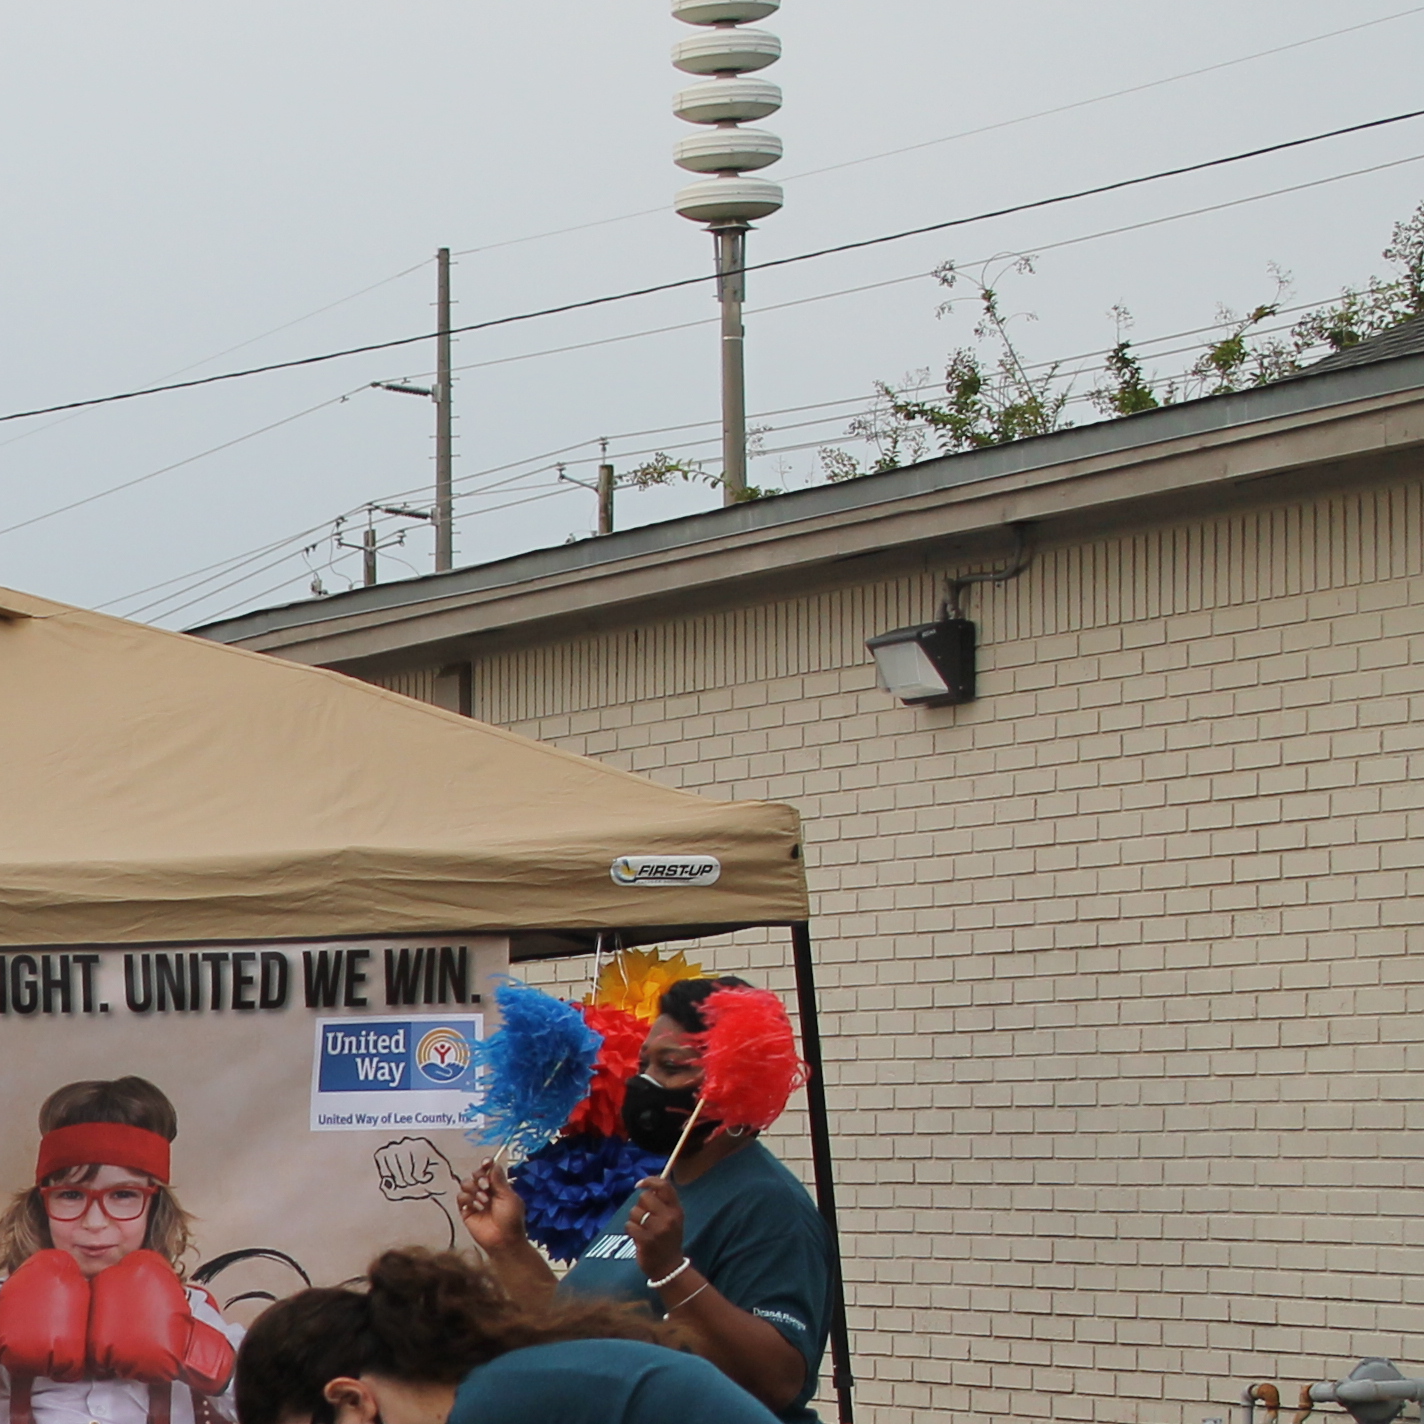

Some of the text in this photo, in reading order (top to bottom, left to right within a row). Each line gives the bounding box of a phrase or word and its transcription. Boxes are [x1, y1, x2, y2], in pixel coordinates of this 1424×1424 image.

[124, 952, 289, 1012] UNITED
[303, 949, 370, 1008] WE
[384, 946, 481, 1006] WIN.
[326, 1029, 406, 1055] United
[355, 1057, 406, 1087] Way
[318, 1114, 353, 1125] United
[354, 1113, 378, 1126] Way
[380, 1112, 392, 1124] of
[394, 1113, 413, 1124] Lee
[415, 1111, 456, 1125] County,
